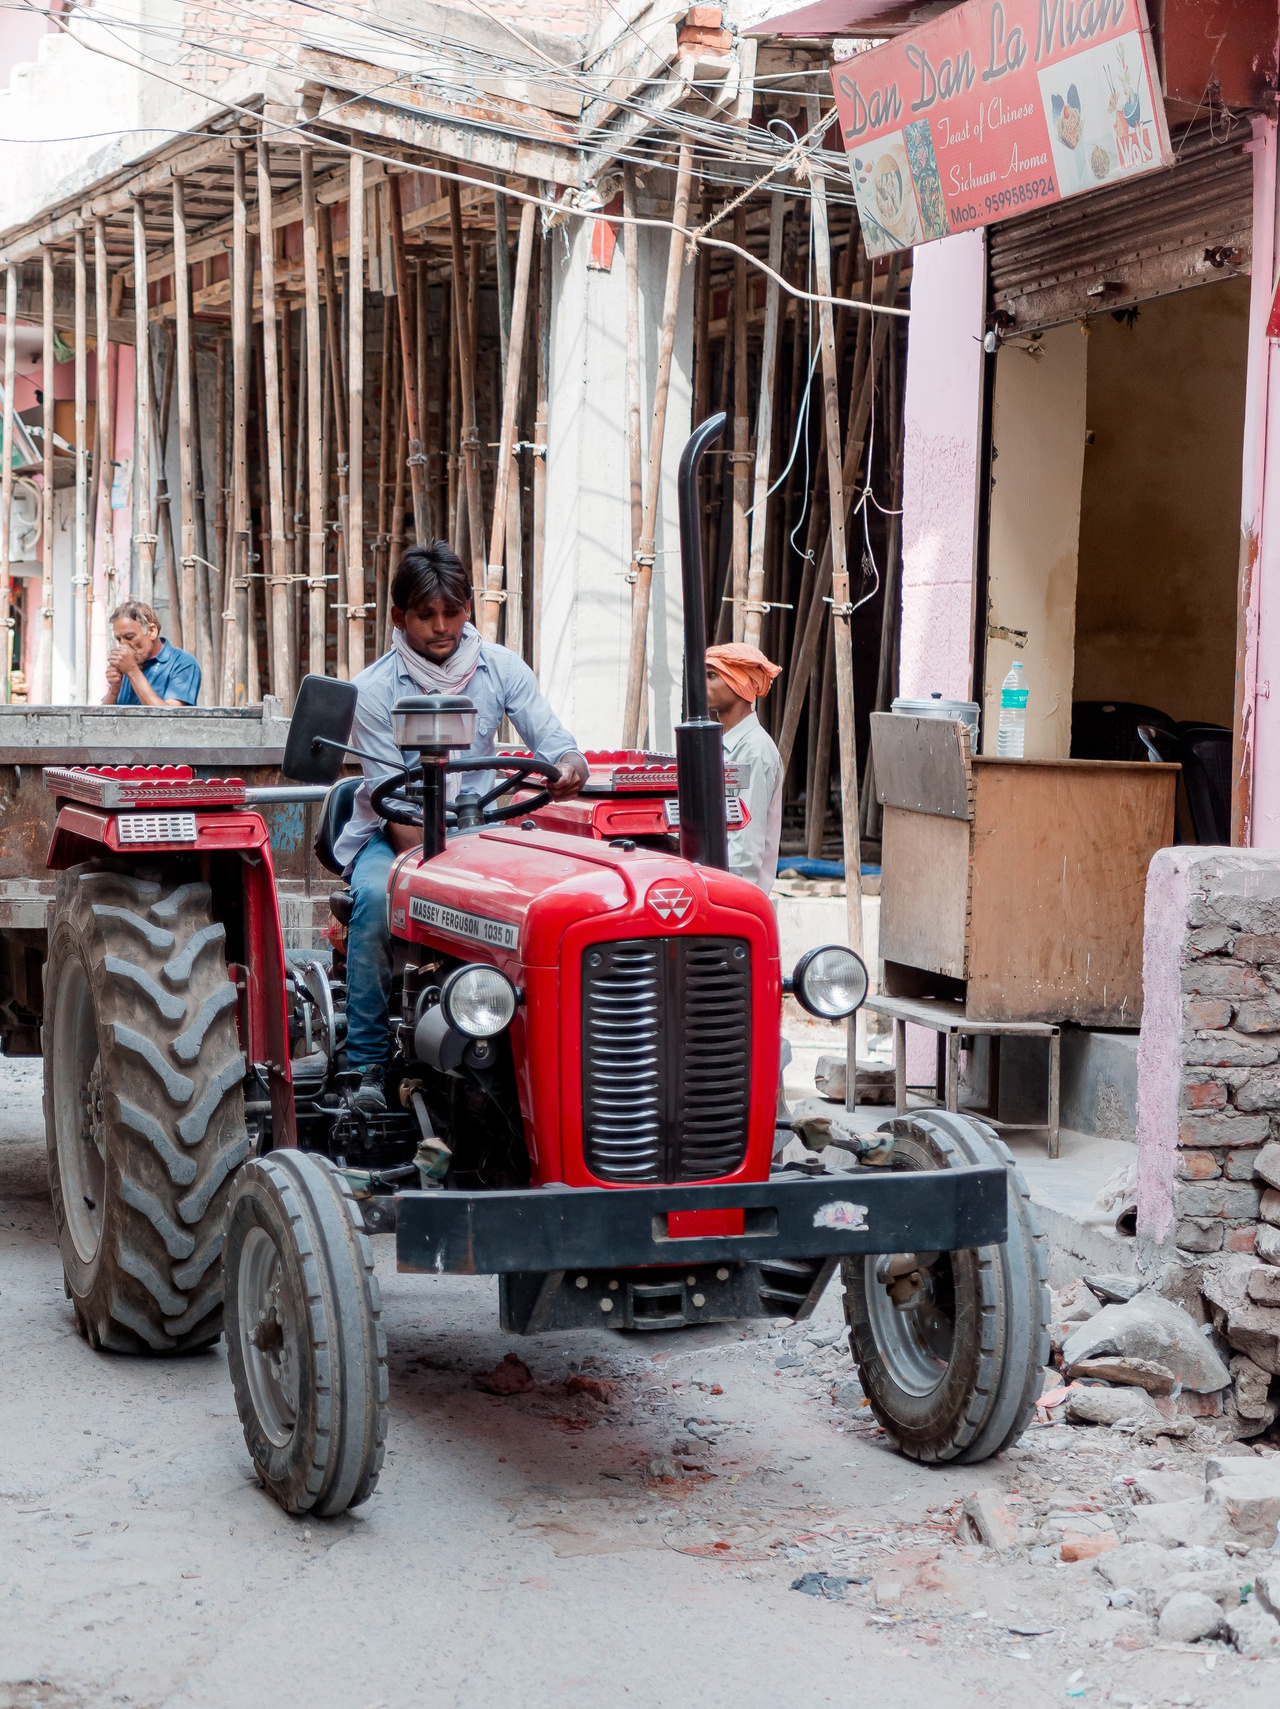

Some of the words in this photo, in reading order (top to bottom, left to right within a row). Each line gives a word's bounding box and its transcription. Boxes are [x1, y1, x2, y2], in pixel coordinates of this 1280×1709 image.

[838, 75, 903, 140] Dan
[905, 44, 976, 113] Dan
[981, 1, 1028, 83] La
[973, 102, 985, 143] of
[987, 96, 1035, 131] Chinese
[947, 161, 997, 197] Sichuan
[1000, 142, 1049, 179] Aroma
[984, 175, 1056, 215] 9599585924
[412, 900, 440, 923] MASSEY
[441, 910, 480, 937] FERGUSON
[483, 923, 503, 943] 1035
[504, 928, 514, 946] DI
